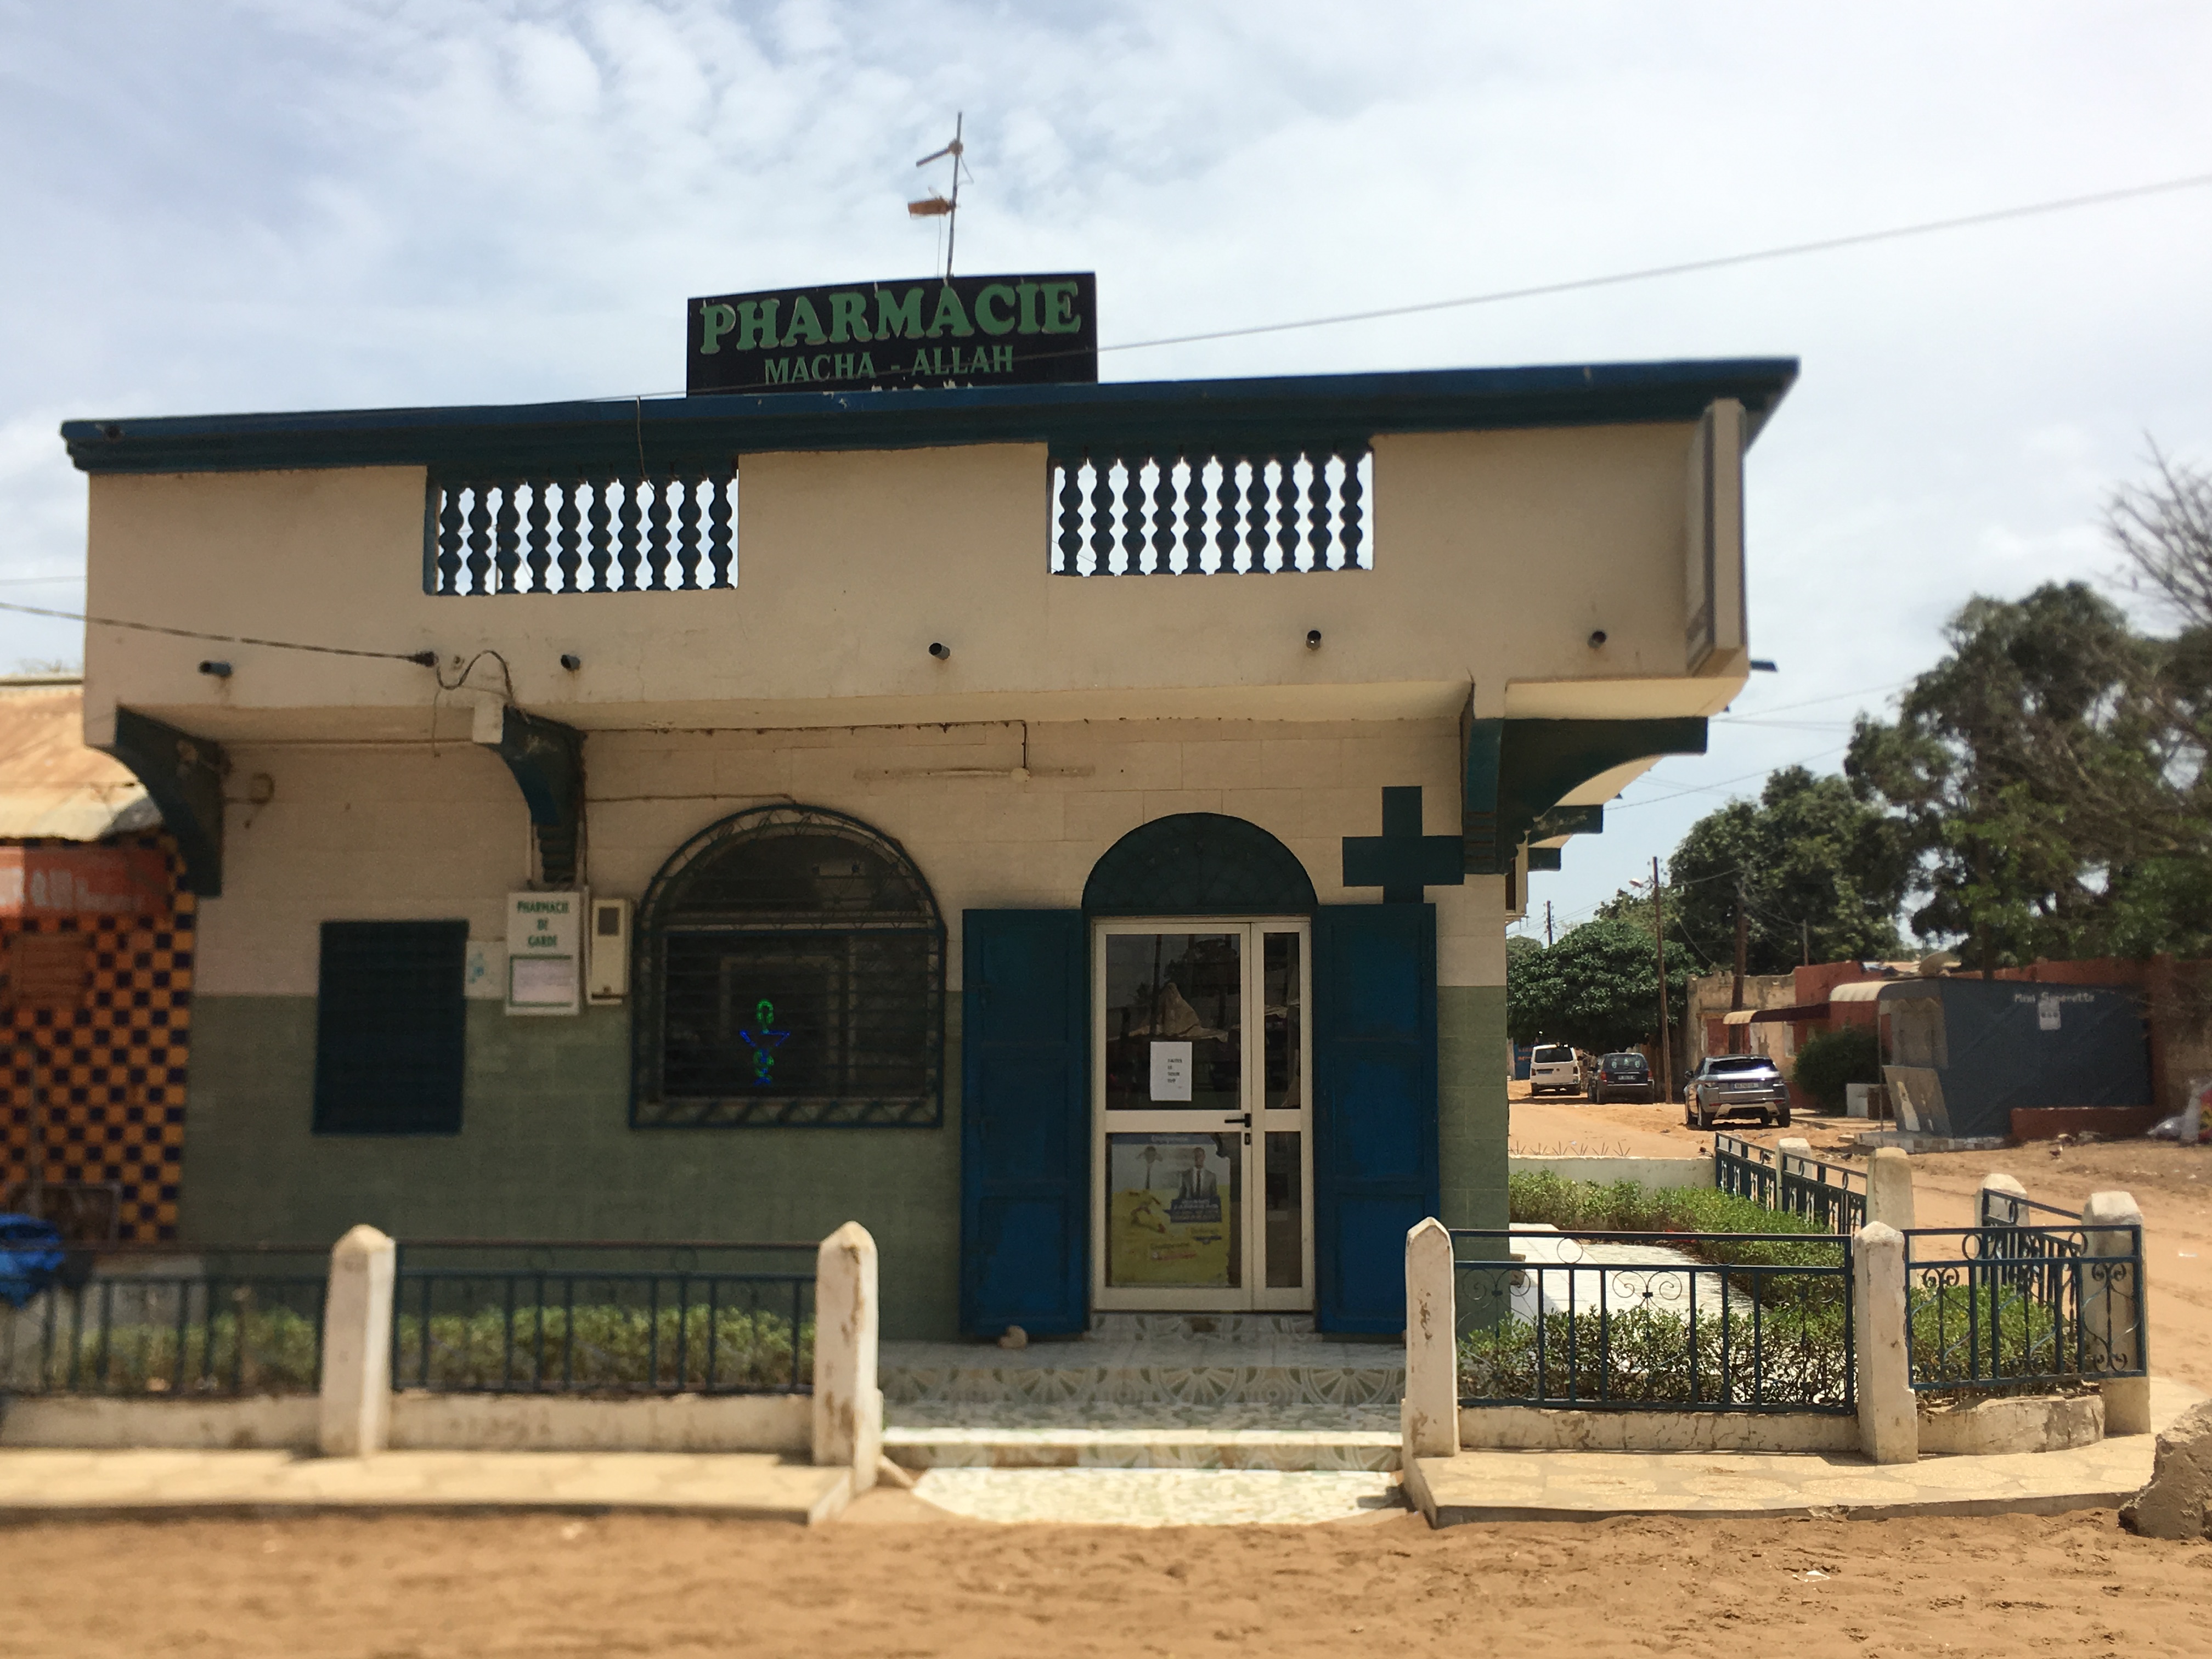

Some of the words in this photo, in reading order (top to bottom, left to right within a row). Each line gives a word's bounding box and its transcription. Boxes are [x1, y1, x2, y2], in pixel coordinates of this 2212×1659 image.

[699, 281, 1081, 354] PHARMACIE
[765, 353, 876, 385] MACHA
[913, 346, 1014, 376] ALLAH
